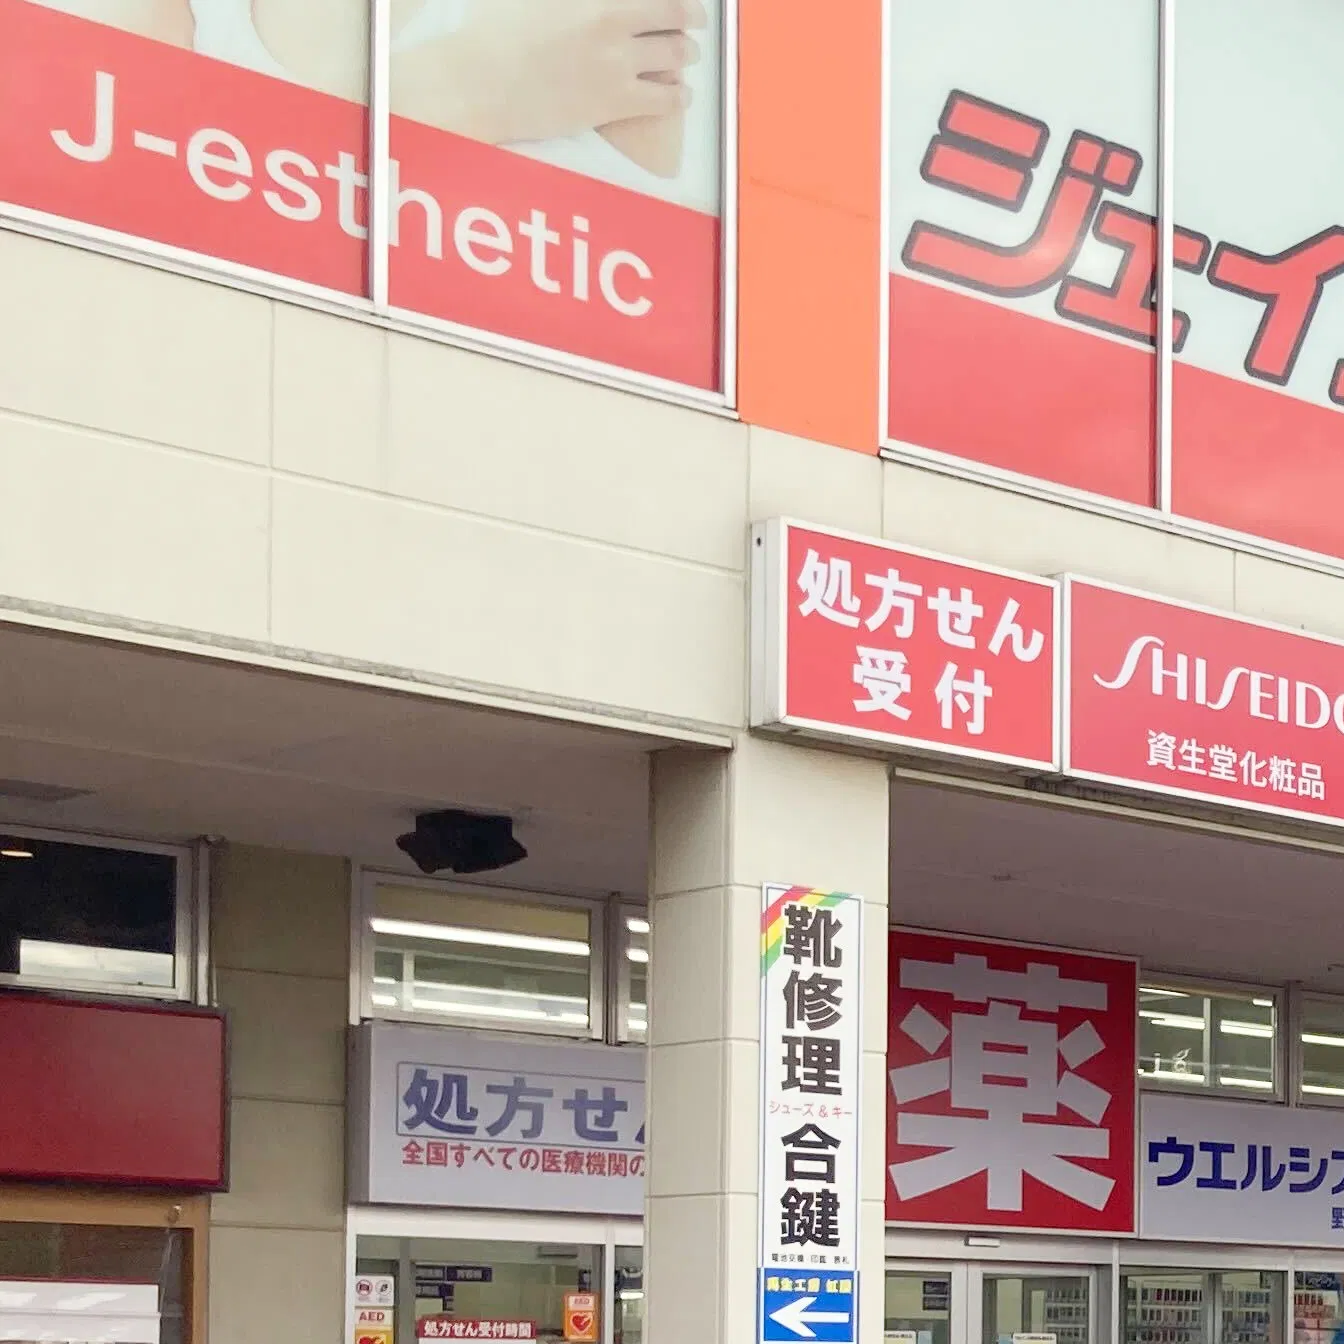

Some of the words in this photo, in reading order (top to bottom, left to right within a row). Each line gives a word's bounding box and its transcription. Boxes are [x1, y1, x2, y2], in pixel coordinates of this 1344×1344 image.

[49, 70, 655, 318] J-esthetic
[796, 548, 1045, 662] 処方せん
[852, 644, 993, 735] 受付
[1145, 729, 1327, 801] 資生堂化粧品
[782, 903, 844, 1097] 靴修理
[401, 1067, 645, 1144] 処方せ
[769, 1100, 815, 1117] シューズ
[818, 1104, 829, 1119] &
[831, 1106, 853, 1119] キー
[887, 950, 1117, 1213] 薬
[779, 1122, 842, 1249] 合鍵
[359, 1311, 385, 1321] AED
[423, 1320, 533, 1338] 処方せん受付時間
